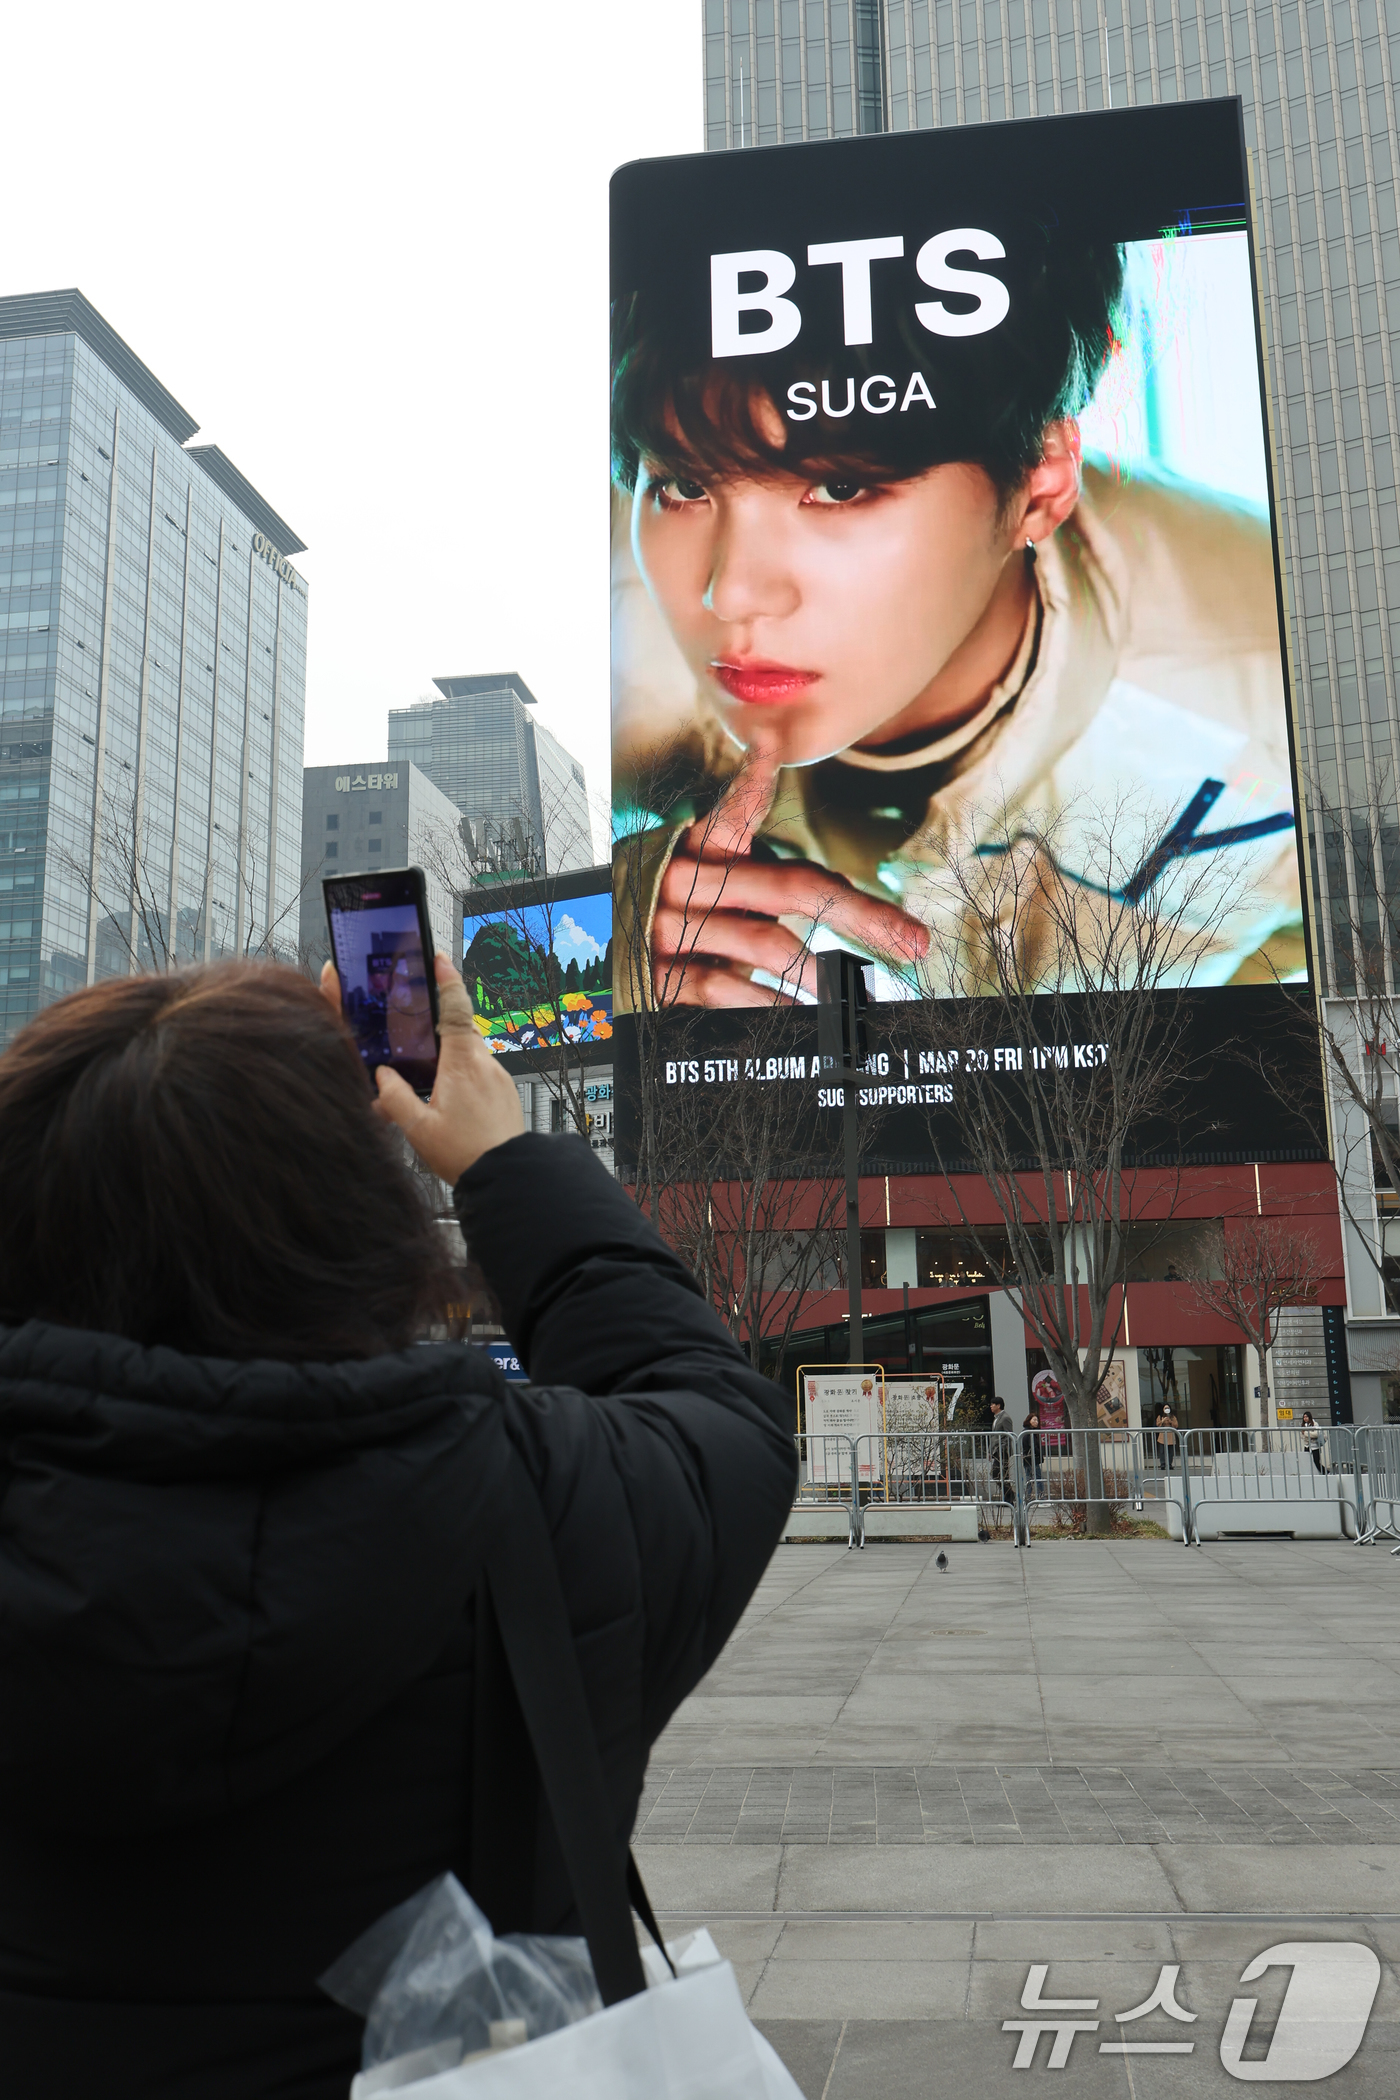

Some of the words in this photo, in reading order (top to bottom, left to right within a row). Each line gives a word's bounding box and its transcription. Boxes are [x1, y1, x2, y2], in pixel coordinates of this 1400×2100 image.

[710, 228, 1011, 359] BTS
[786, 371, 937, 421] SUGA
[252, 532, 297, 590] OFFICIA
[335, 773, 398, 792] 에스타워
[666, 1060, 699, 1084] BTS
[704, 1058, 738, 1083] 5TH
[744, 1056, 806, 1081] ALBUM
[919, 1050, 959, 1074] MAR
[994, 1047, 1022, 1071] FRI
[818, 1088, 857, 1107] SUG
[859, 1084, 953, 1106] SUPPORTERS
[942, 1363, 959, 1371] 광화문
[940, 1383, 964, 1420] 7
